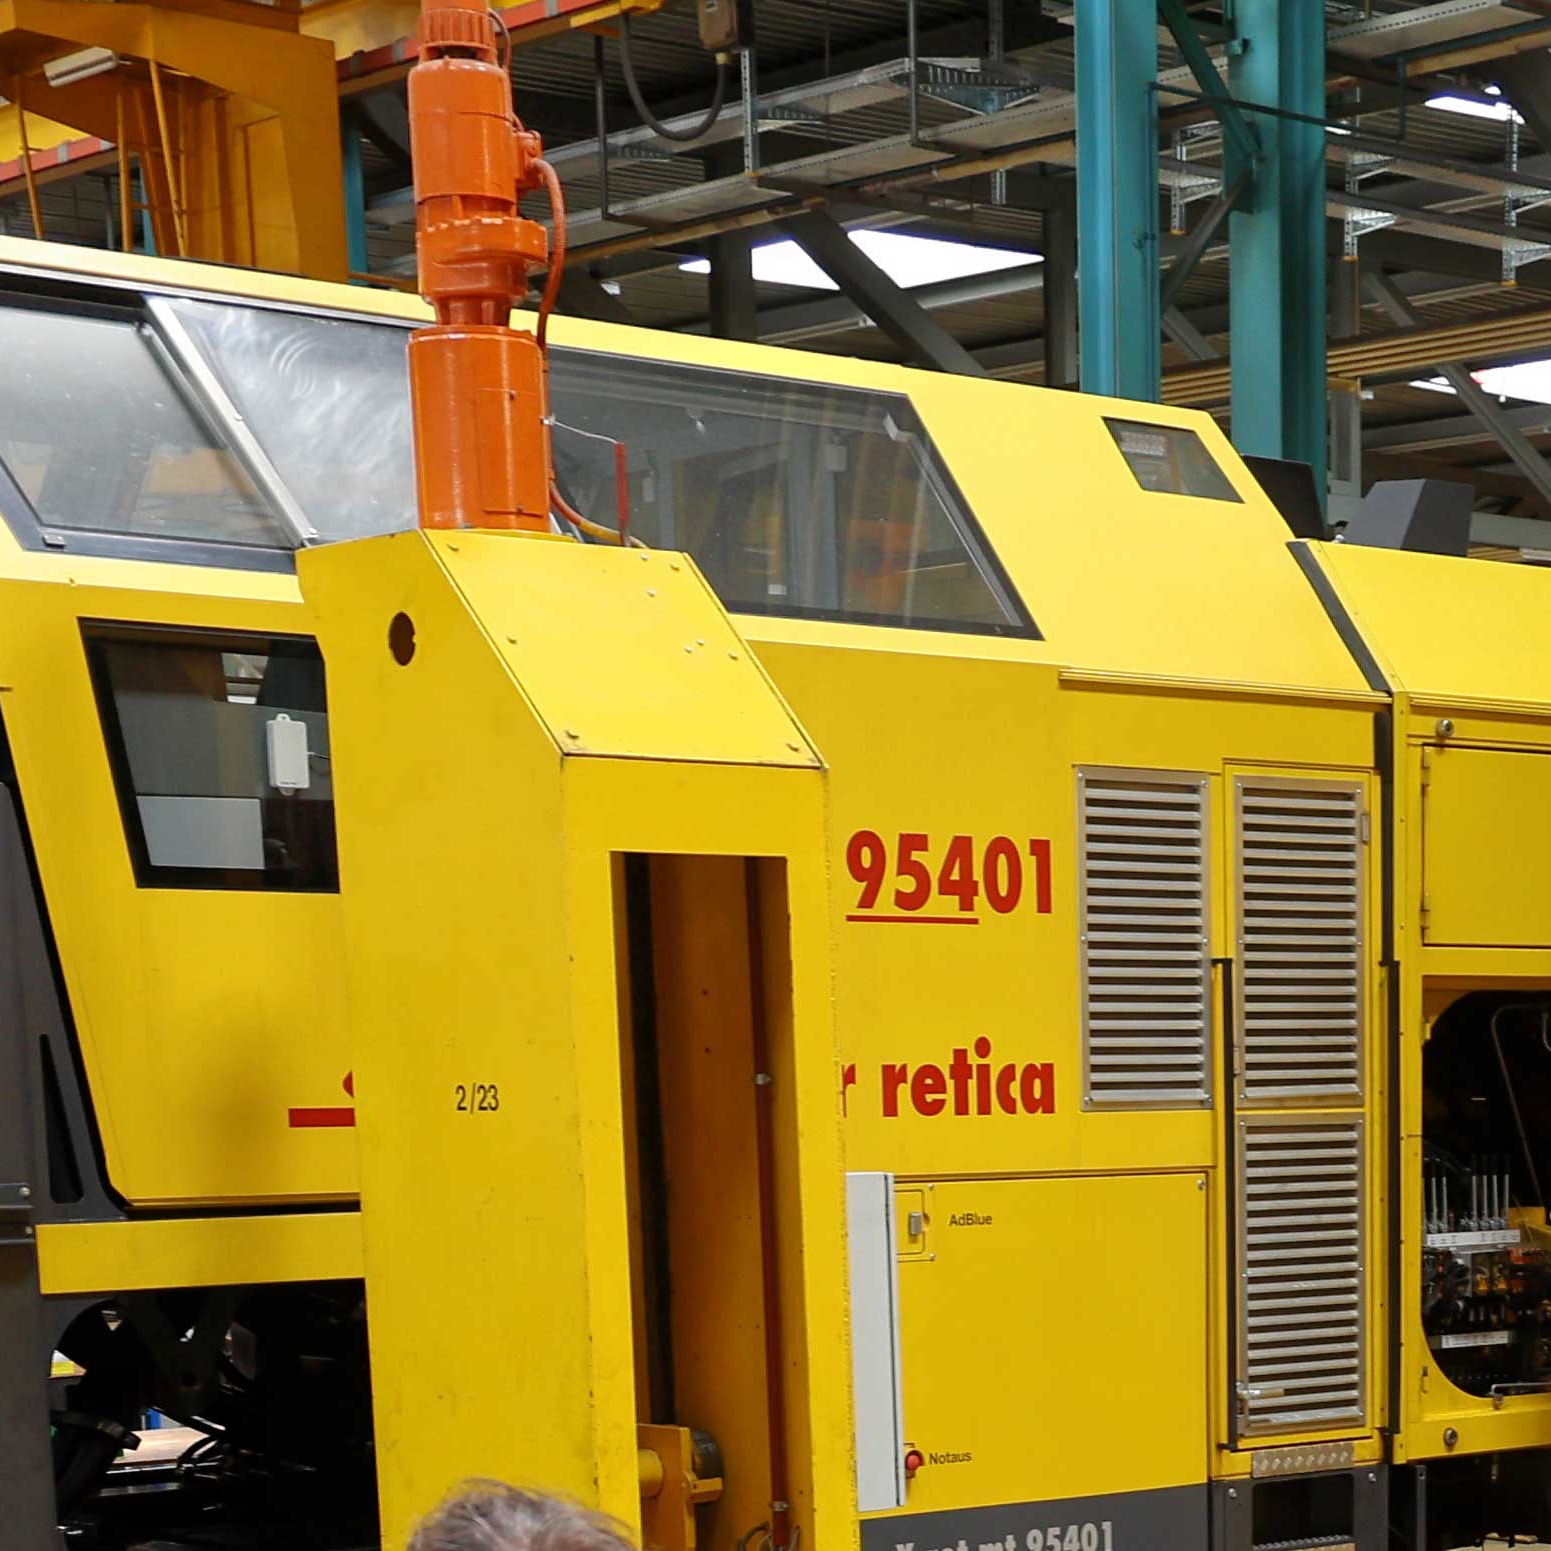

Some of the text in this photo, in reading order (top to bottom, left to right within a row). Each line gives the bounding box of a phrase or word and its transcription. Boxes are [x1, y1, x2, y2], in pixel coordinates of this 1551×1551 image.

[846, 829, 1053, 916] 95401
[881, 1036, 1056, 1118] retica
[455, 1082, 500, 1114] 2/23
[948, 1212, 993, 1227] AdBlue
[929, 1451, 973, 1465] Notaus
